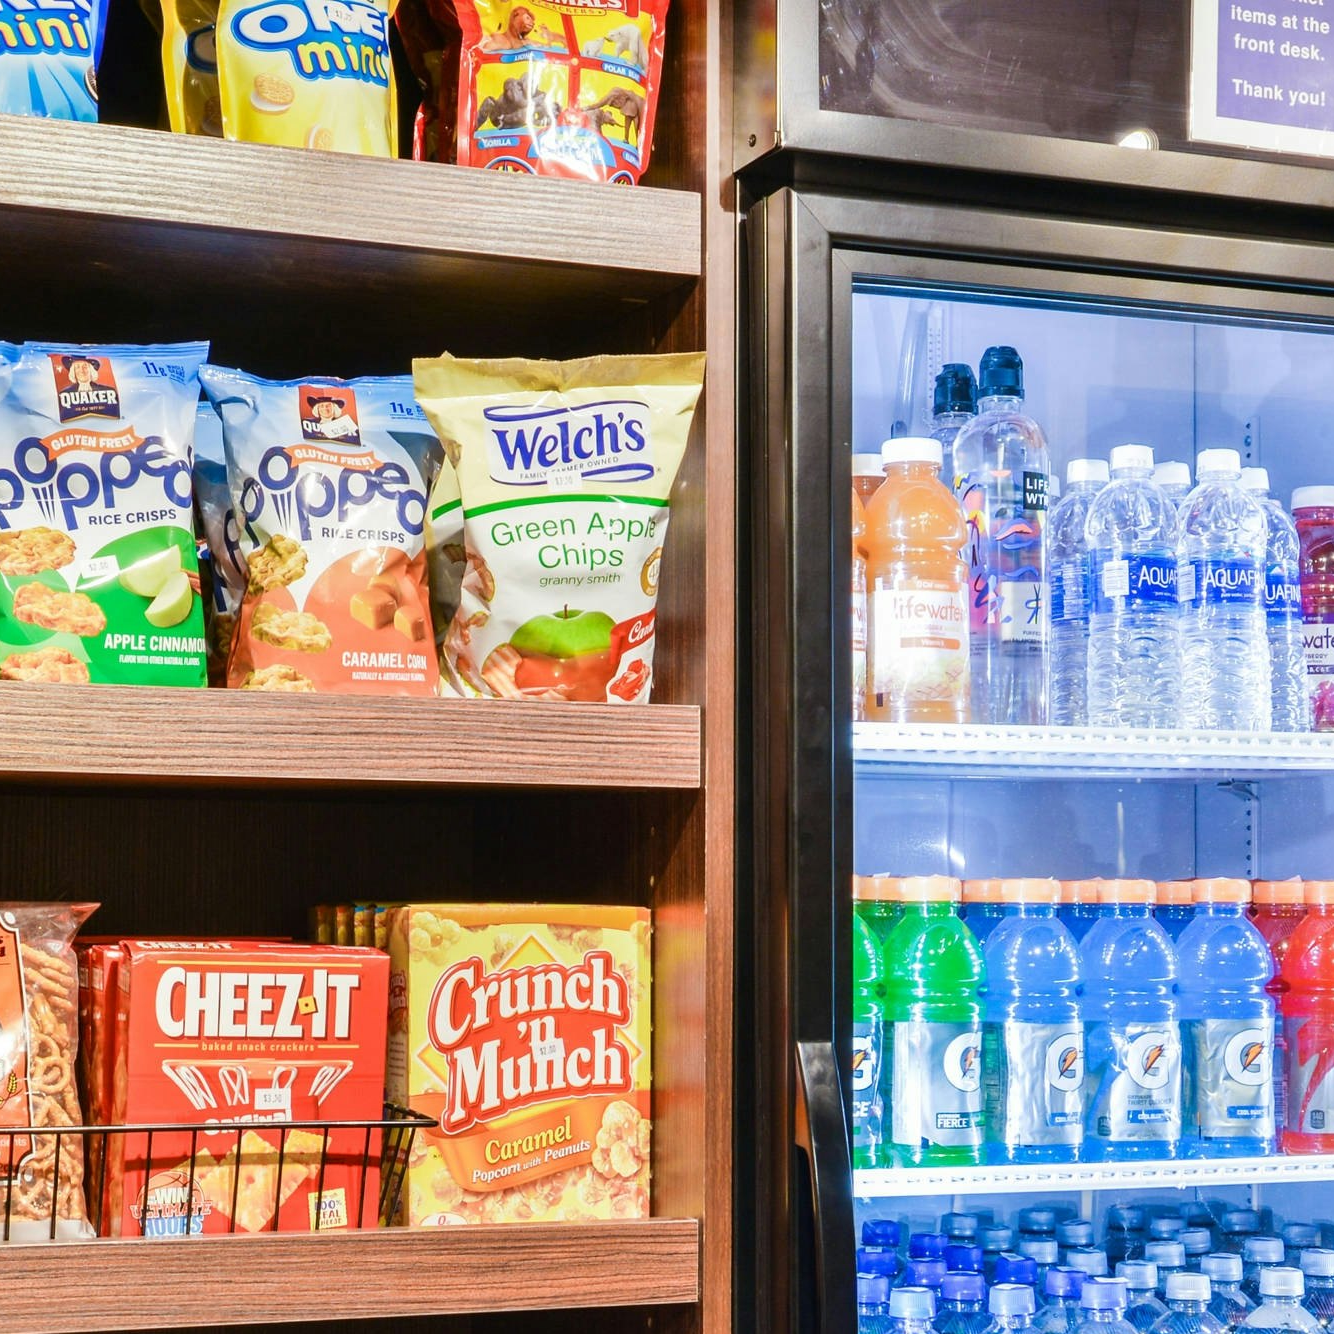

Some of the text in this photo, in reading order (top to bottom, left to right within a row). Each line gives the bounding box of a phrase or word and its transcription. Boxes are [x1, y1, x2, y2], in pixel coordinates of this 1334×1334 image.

[1231, 5, 1330, 34] items at the
[297, 36, 387, 80] mini
[1234, 34, 1325, 61] front desk.
[1232, 79, 1326, 106] Thank you!
[60, 389, 118, 408] QUAKER
[51, 432, 135, 450] GLUTEN FREE!
[492, 412, 645, 471] Welch's
[1026, 478, 1048, 491] LIFE
[89, 508, 177, 526] RICE CRISPS
[491, 513, 655, 546] Green Apple
[322, 527, 405, 544] RICE CRISPS
[539, 543, 623, 571] Chips
[540, 572, 621, 587] granny smith
[343, 652, 427, 669] CARAMEL CORN
[434, 958, 621, 1047] Crunch
[202, 1041, 314, 1052] baked snack crackers
[450, 1028, 624, 1123] Munch
[938, 1118, 968, 1128] FIERCE
[486, 1116, 572, 1164] Caramel
